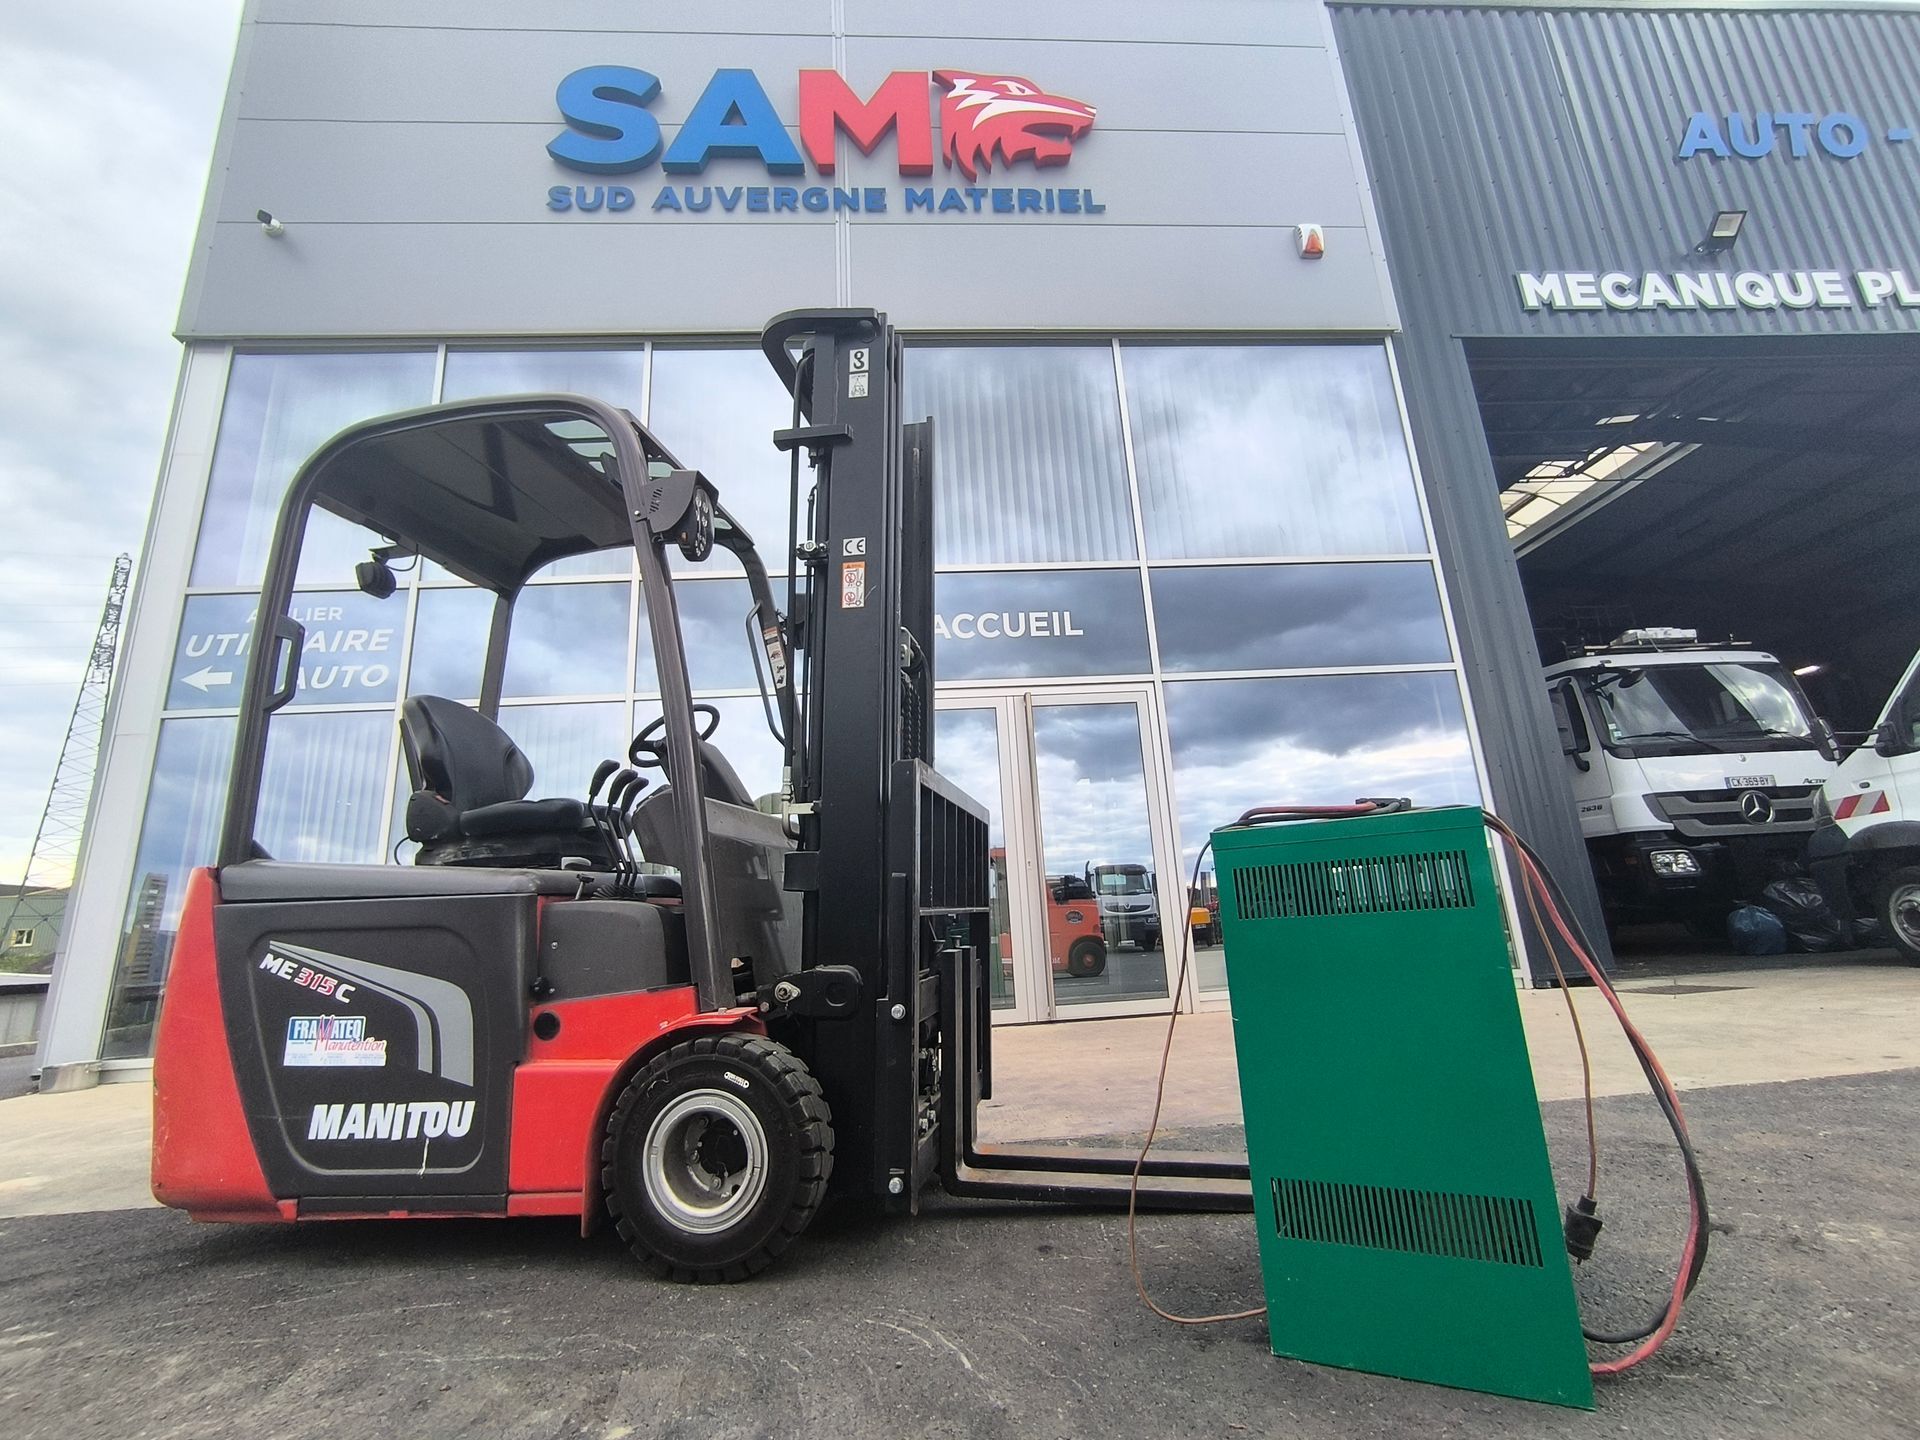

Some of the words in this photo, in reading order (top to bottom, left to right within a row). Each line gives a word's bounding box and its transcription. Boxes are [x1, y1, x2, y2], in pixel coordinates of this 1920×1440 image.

[546, 65, 933, 176] SAM
[1679, 112, 1869, 159] AUTO
[547, 186, 635, 211] SUD
[652, 186, 887, 213] AUVERGNE
[905, 187, 1106, 214] MATERIEL
[1518, 271, 1852, 311] MECANIQUE
[246, 607, 343, 623] ALIER
[934, 611, 1084, 639] ACCUEIL
[185, 628, 393, 657] UTIAIRE
[307, 1101, 476, 1140] MANITOU
